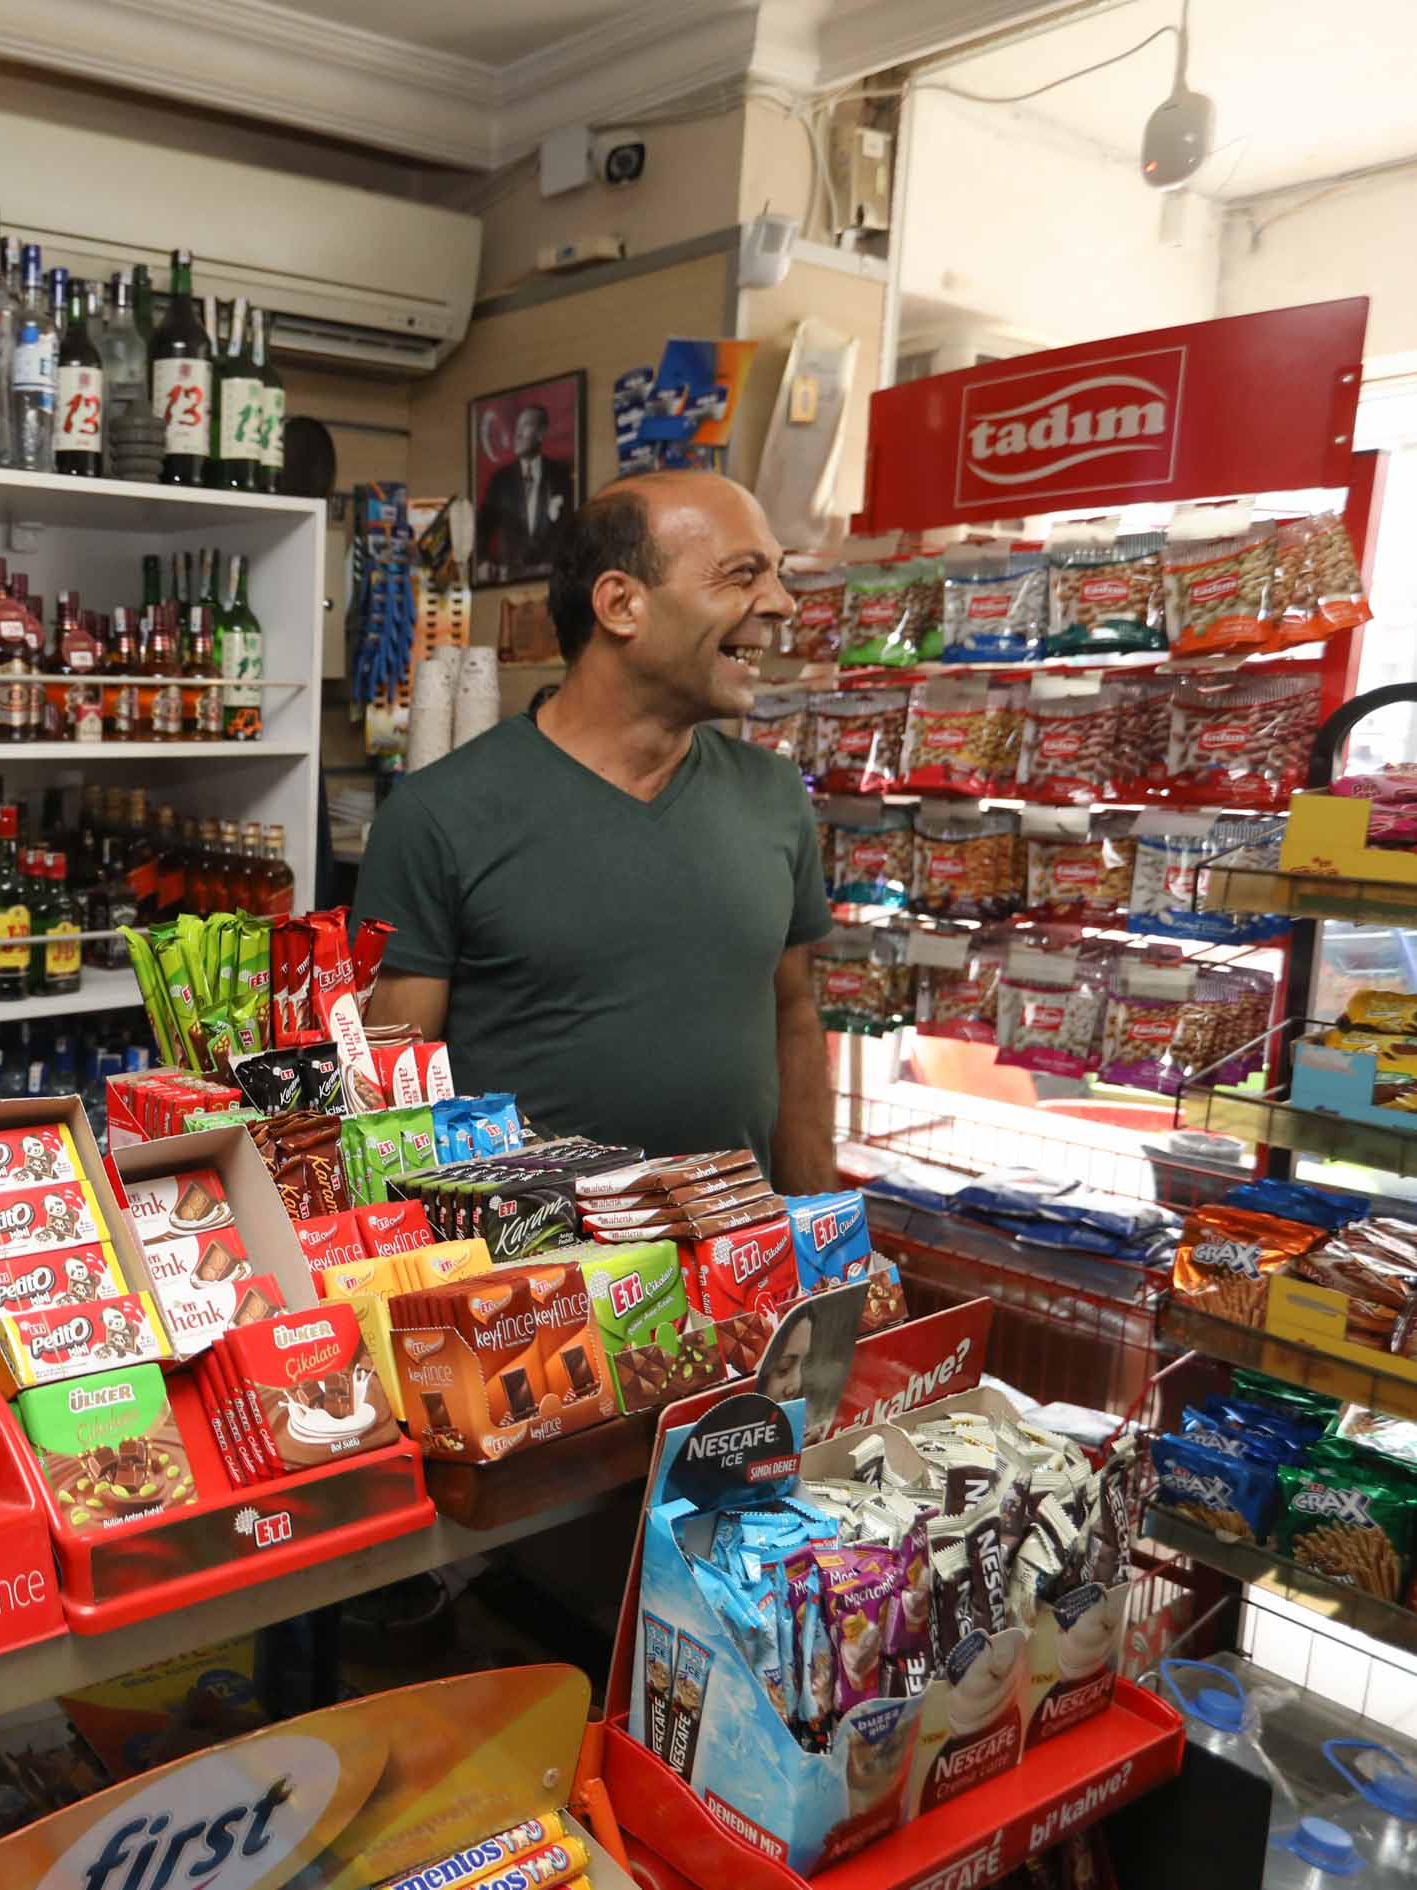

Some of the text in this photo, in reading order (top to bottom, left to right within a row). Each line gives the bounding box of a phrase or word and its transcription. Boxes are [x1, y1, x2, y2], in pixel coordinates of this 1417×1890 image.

[968, 400, 1166, 460] tadım
[334, 1012, 365, 1063] ahenk
[377, 1140, 396, 1157] ETi
[414, 1133, 431, 1150] ETi
[132, 1194, 168, 1219] enk
[499, 1200, 517, 1217] ETi
[493, 1196, 573, 1256] Karam
[811, 1211, 838, 1253] ETi
[152, 1254, 188, 1281] enk
[731, 1240, 763, 1284] ETi
[533, 1293, 592, 1329] keyfince
[609, 1271, 644, 1320] ETi
[167, 1301, 225, 1333] henk
[273, 1320, 335, 1349] ÜLKER
[473, 1312, 536, 1351] keyfince
[285, 1343, 341, 1382] Çikolata
[874, 1338, 971, 1424] kahve?
[69, 1384, 135, 1414] ÜLKER
[330, 1436, 362, 1454] Bol Sütlü
[720, 1451, 744, 1469] ICE
[771, 1458, 798, 1475] DENE!
[123, 1511, 145, 1526] Antep
[1293, 1487, 1380, 1530] CRAX
[252, 1511, 292, 1549] ETi
[1059, 1762, 1132, 1830] kahve?
[84, 1782, 296, 1890] first
[707, 1796, 759, 1846] DENEDİN
[392, 1838, 503, 1890] mentos
